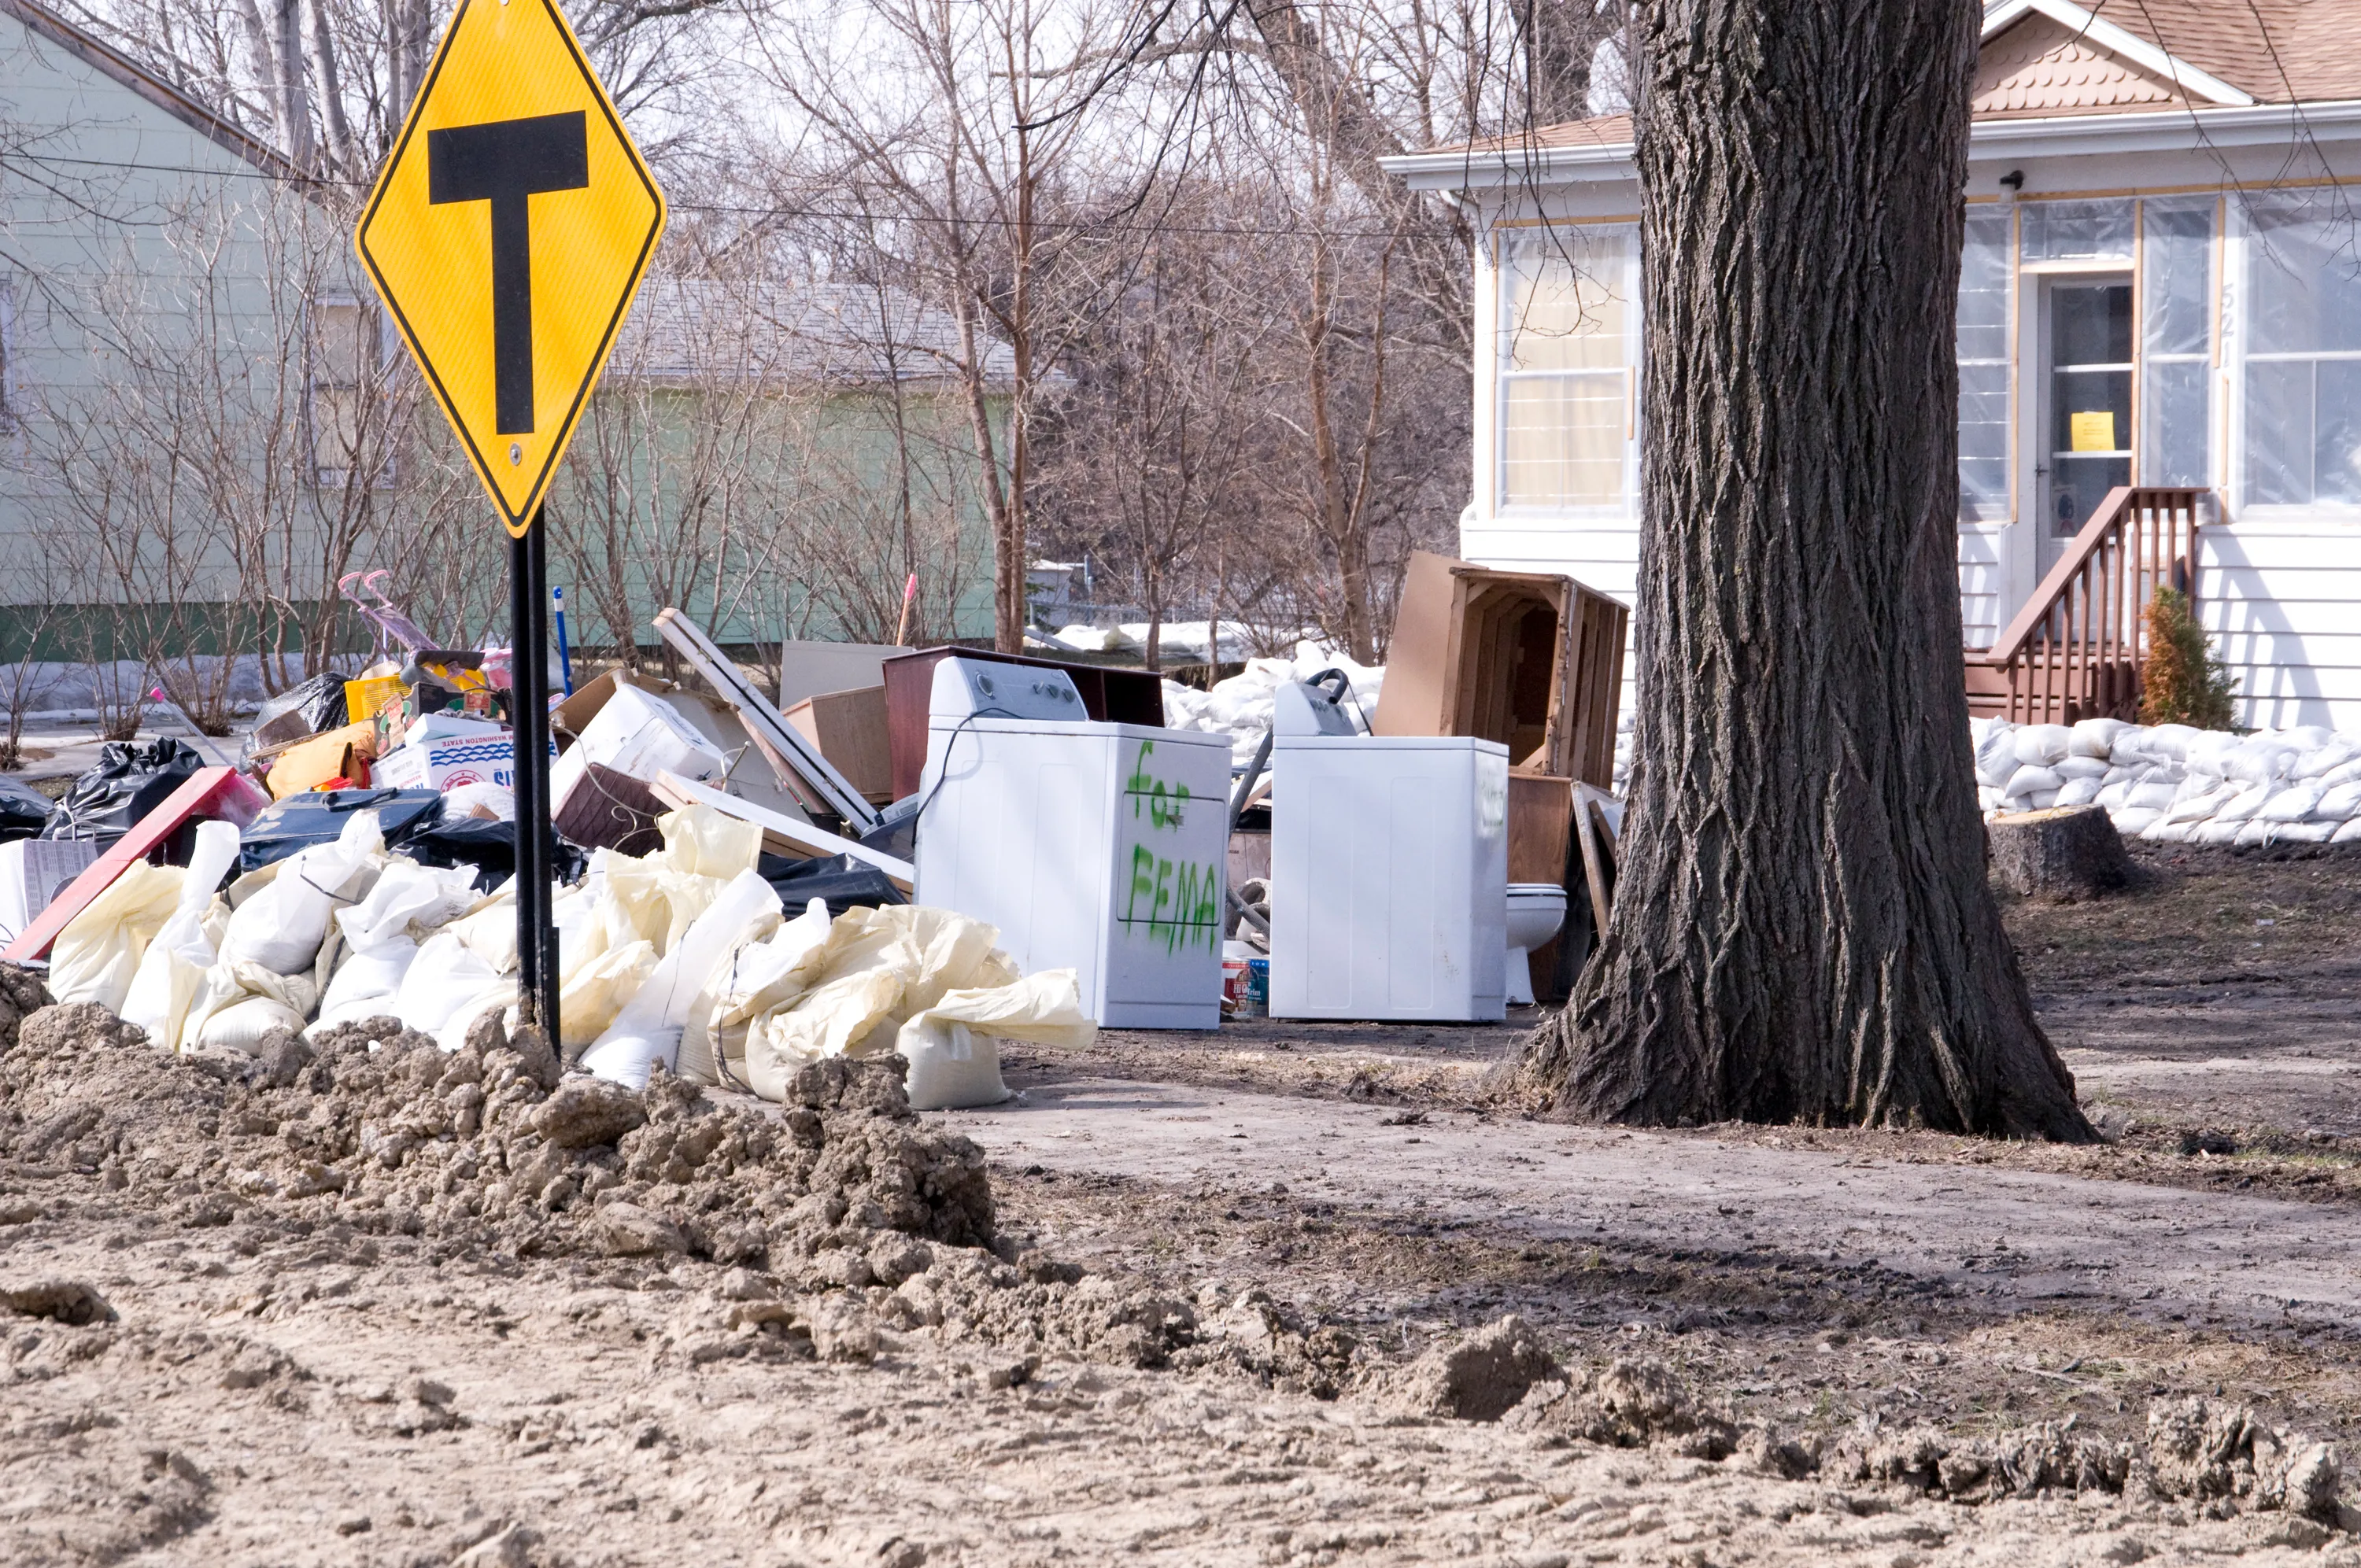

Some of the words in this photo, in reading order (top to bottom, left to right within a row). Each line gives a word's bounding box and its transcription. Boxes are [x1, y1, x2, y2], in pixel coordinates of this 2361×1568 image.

[442, 739, 464, 747] STATE
[465, 735, 507, 744] WASHINGTON
[1128, 843, 1215, 957] FEMA
